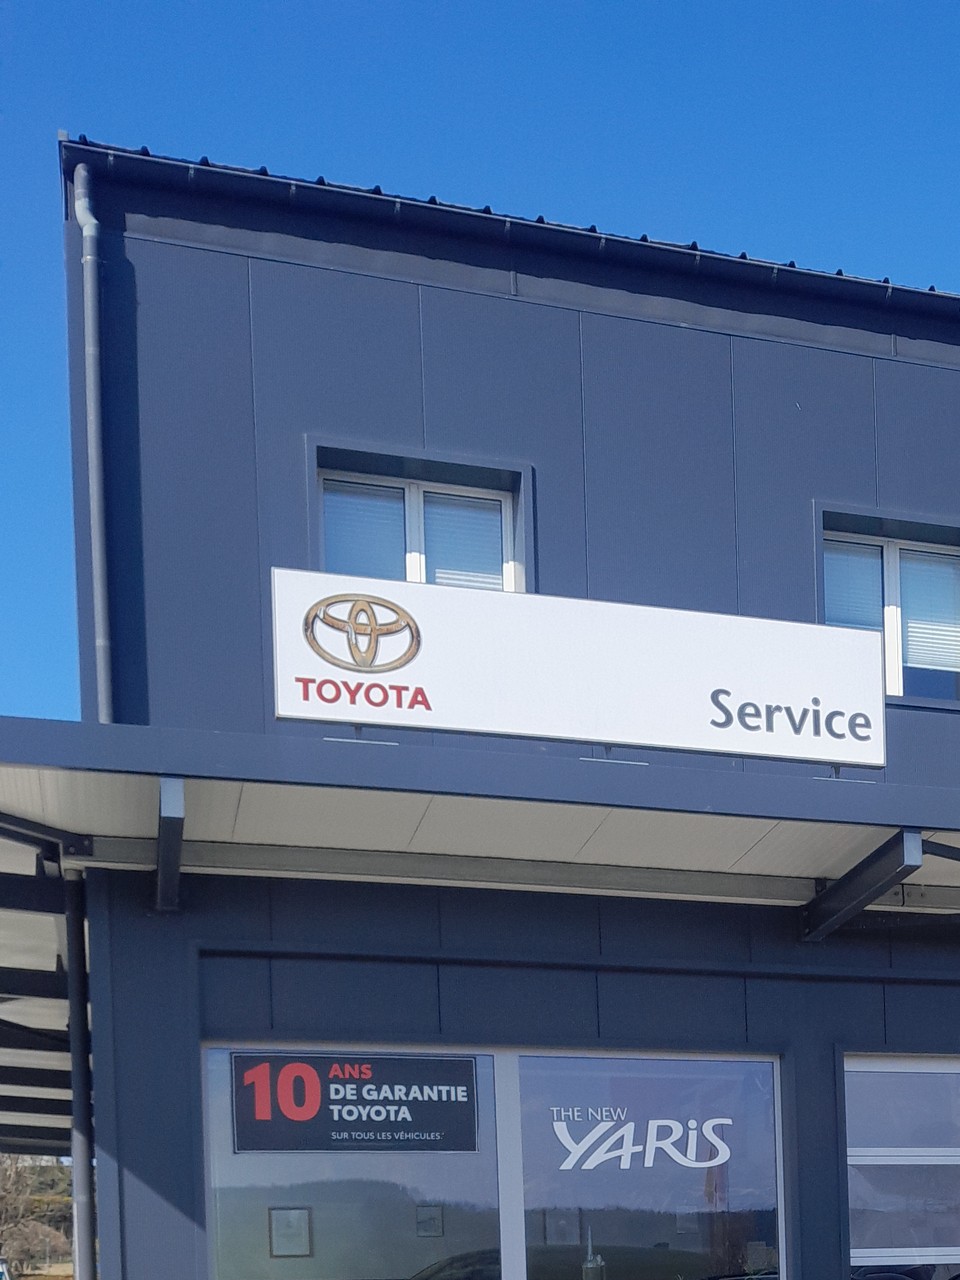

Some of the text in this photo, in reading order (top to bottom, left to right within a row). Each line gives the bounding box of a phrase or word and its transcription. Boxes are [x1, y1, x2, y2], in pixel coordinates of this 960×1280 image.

[294, 677, 432, 711] TOYOTA
[710, 689, 872, 741] Service
[328, 1063, 372, 1080] ANS
[243, 1062, 321, 1122] 10
[329, 1084, 468, 1102] DE GARANTIE
[329, 1105, 412, 1122] TOYOTA
[550, 1107, 627, 1121] THE NEW
[331, 1132, 349, 1140] SUR
[351, 1132, 375, 1140] TOUS
[377, 1132, 393, 1140] LES
